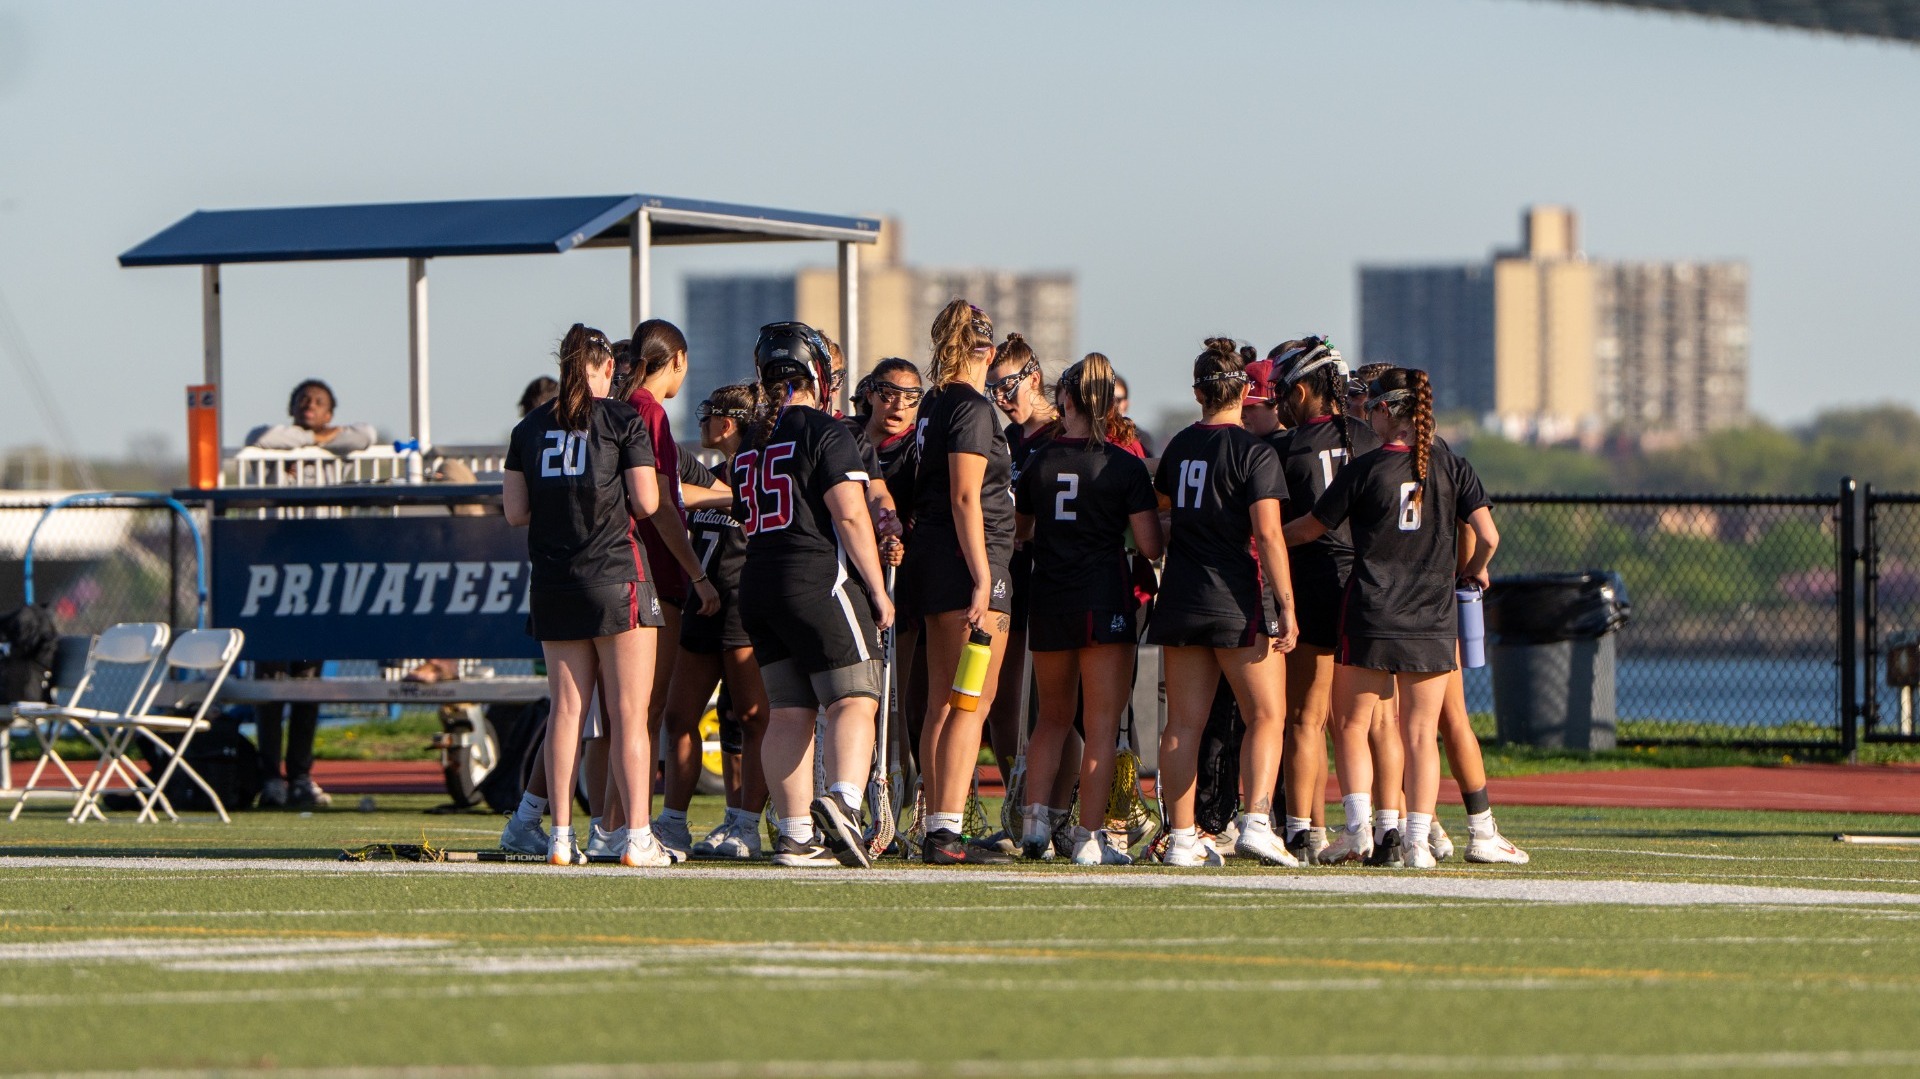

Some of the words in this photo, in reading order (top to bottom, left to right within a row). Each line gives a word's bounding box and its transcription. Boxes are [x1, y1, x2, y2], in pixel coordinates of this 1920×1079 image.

[541, 429, 588, 477] 20
[734, 440, 797, 536] 35
[1054, 472, 1079, 520] 2
[1177, 459, 1208, 508] 19
[701, 530, 720, 574] 7
[240, 561, 532, 617] PRIVATEE
[504, 854, 547, 862] RMOUR
